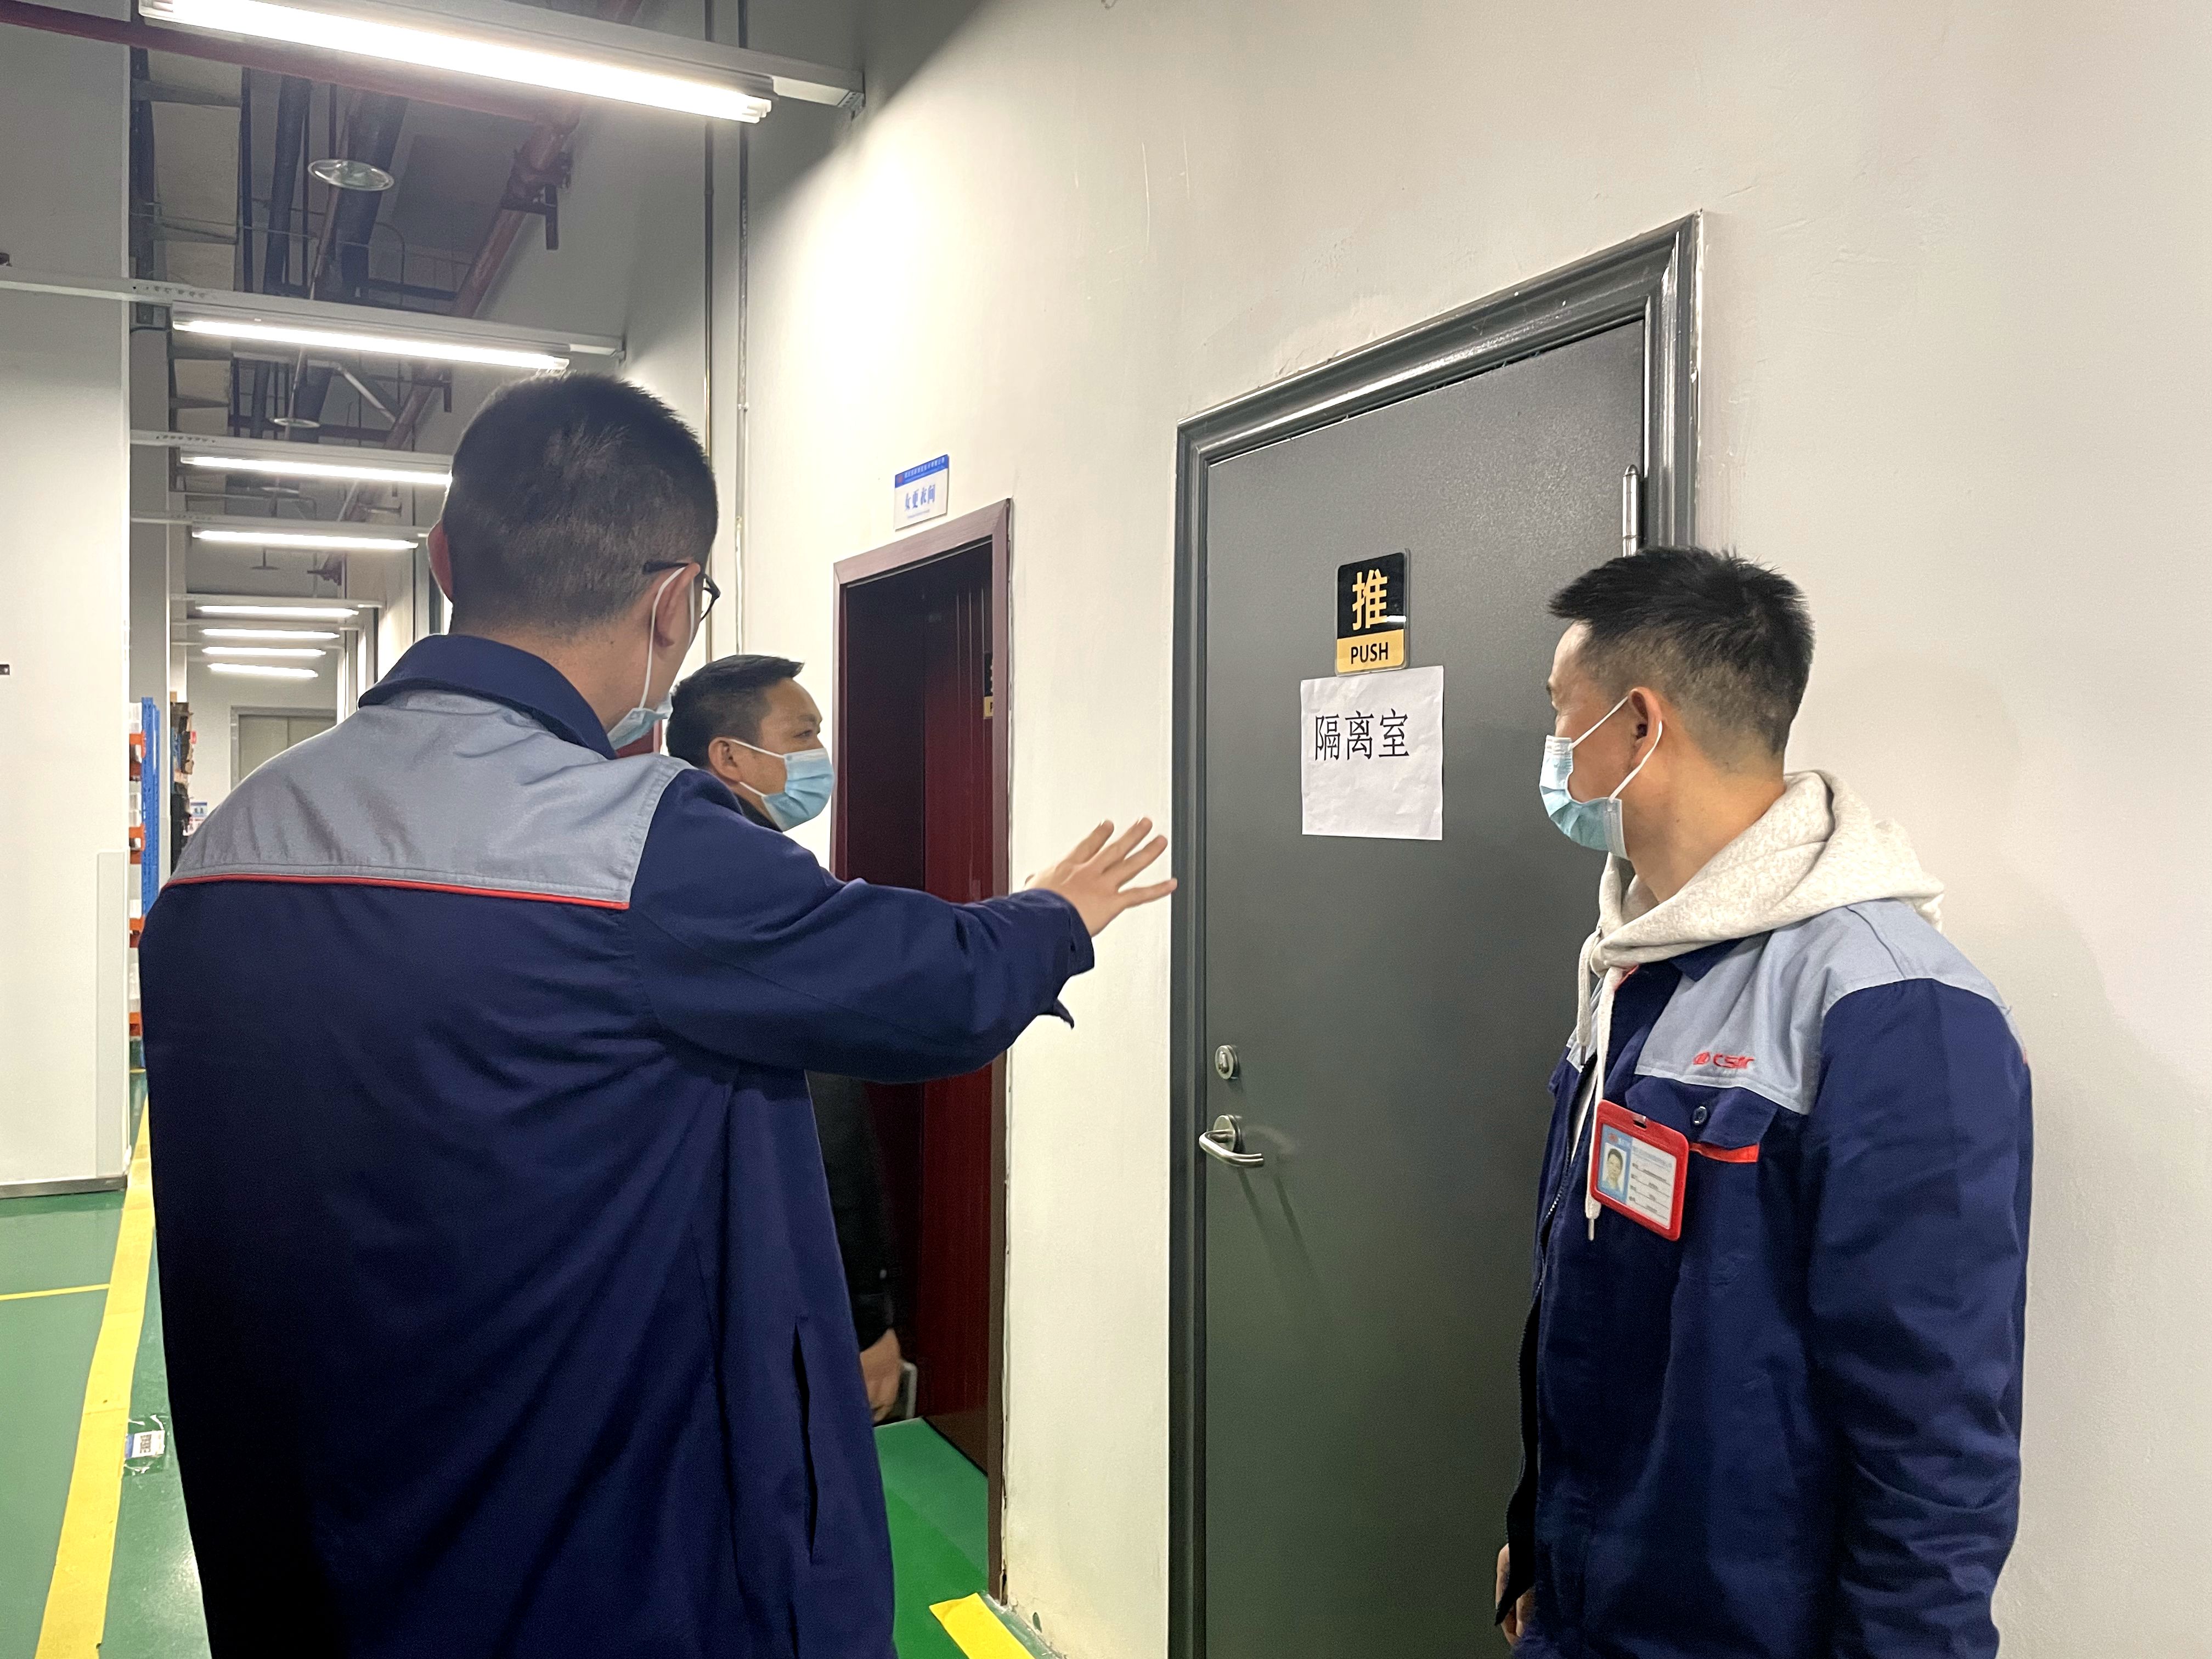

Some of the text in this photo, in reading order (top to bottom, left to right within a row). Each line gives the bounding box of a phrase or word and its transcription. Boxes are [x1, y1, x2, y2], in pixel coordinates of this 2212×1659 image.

[1352, 568, 1388, 630] 推
[1351, 641, 1389, 664] PUSH
[1314, 708, 1409, 761] 隔离室
